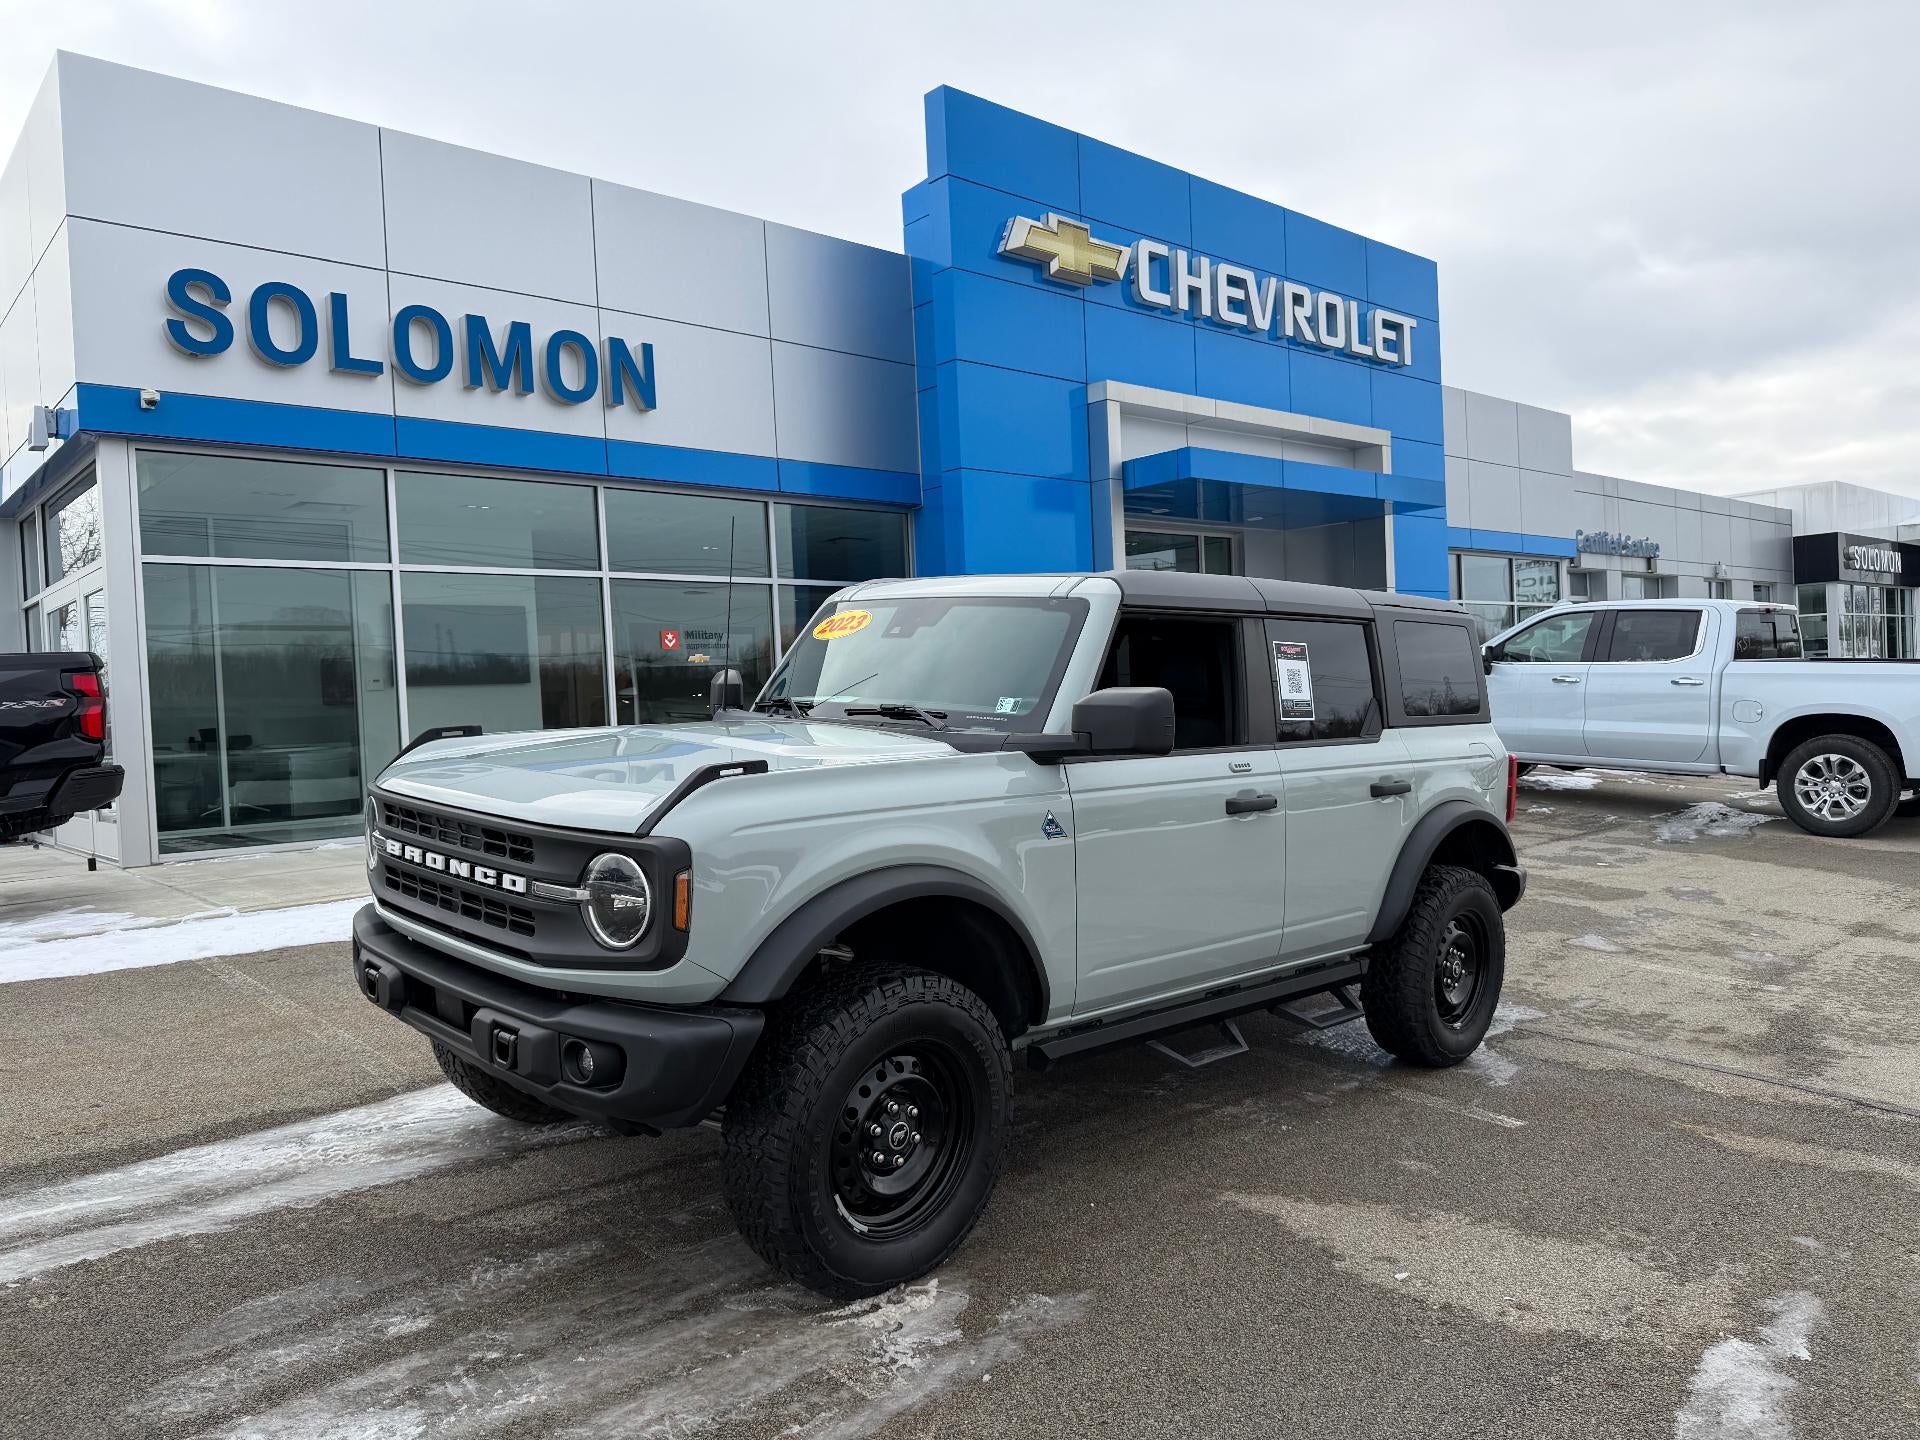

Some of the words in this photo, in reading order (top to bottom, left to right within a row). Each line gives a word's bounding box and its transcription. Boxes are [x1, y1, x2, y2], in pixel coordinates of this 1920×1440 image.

[1129, 238, 1417, 366] CHEVROLET
[163, 268, 657, 411] SOLOMON
[1853, 545, 1902, 573] SOLOMON
[685, 629, 724, 641] Military
[815, 614, 869, 635] 2023
[386, 838, 527, 893] BRONCO
